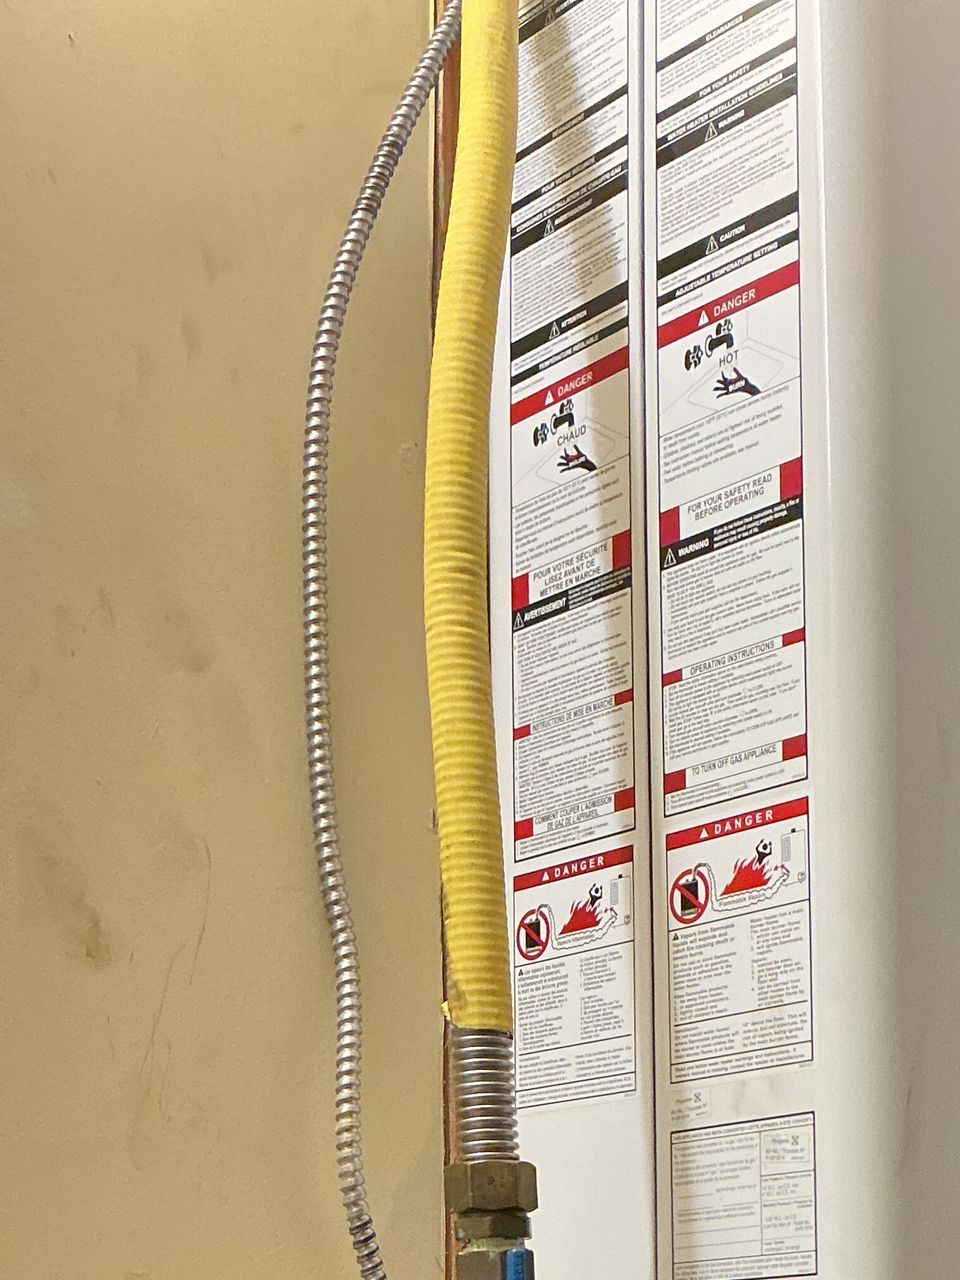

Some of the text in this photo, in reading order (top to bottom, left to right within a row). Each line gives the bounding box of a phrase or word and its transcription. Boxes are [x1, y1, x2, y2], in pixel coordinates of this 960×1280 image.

[720, 224, 746, 242] CAUTION
[713, 288, 756, 317] DANGER
[719, 350, 739, 367] HOT
[557, 371, 593, 397] DANGER
[557, 424, 587, 446] CHAUD
[687, 473, 773, 514] FOR YOUR SAFETY READ
[694, 486, 765, 521] BEFORE OPERATING
[533, 541, 609, 581] POUR VOTRE SÉCURITÉ
[678, 538, 709, 557] WARNING
[540, 566, 601, 597] METTRE EN MARCHE
[544, 559, 596, 586] LISEZ AVANT DE
[690, 640, 775, 676] OPERATING INSTRUCTIONS
[691, 744, 777, 776] TO TURN OFF GAS APPLIANCE
[714, 809, 774, 834] DANGER
[554, 856, 604, 878] DANGER
